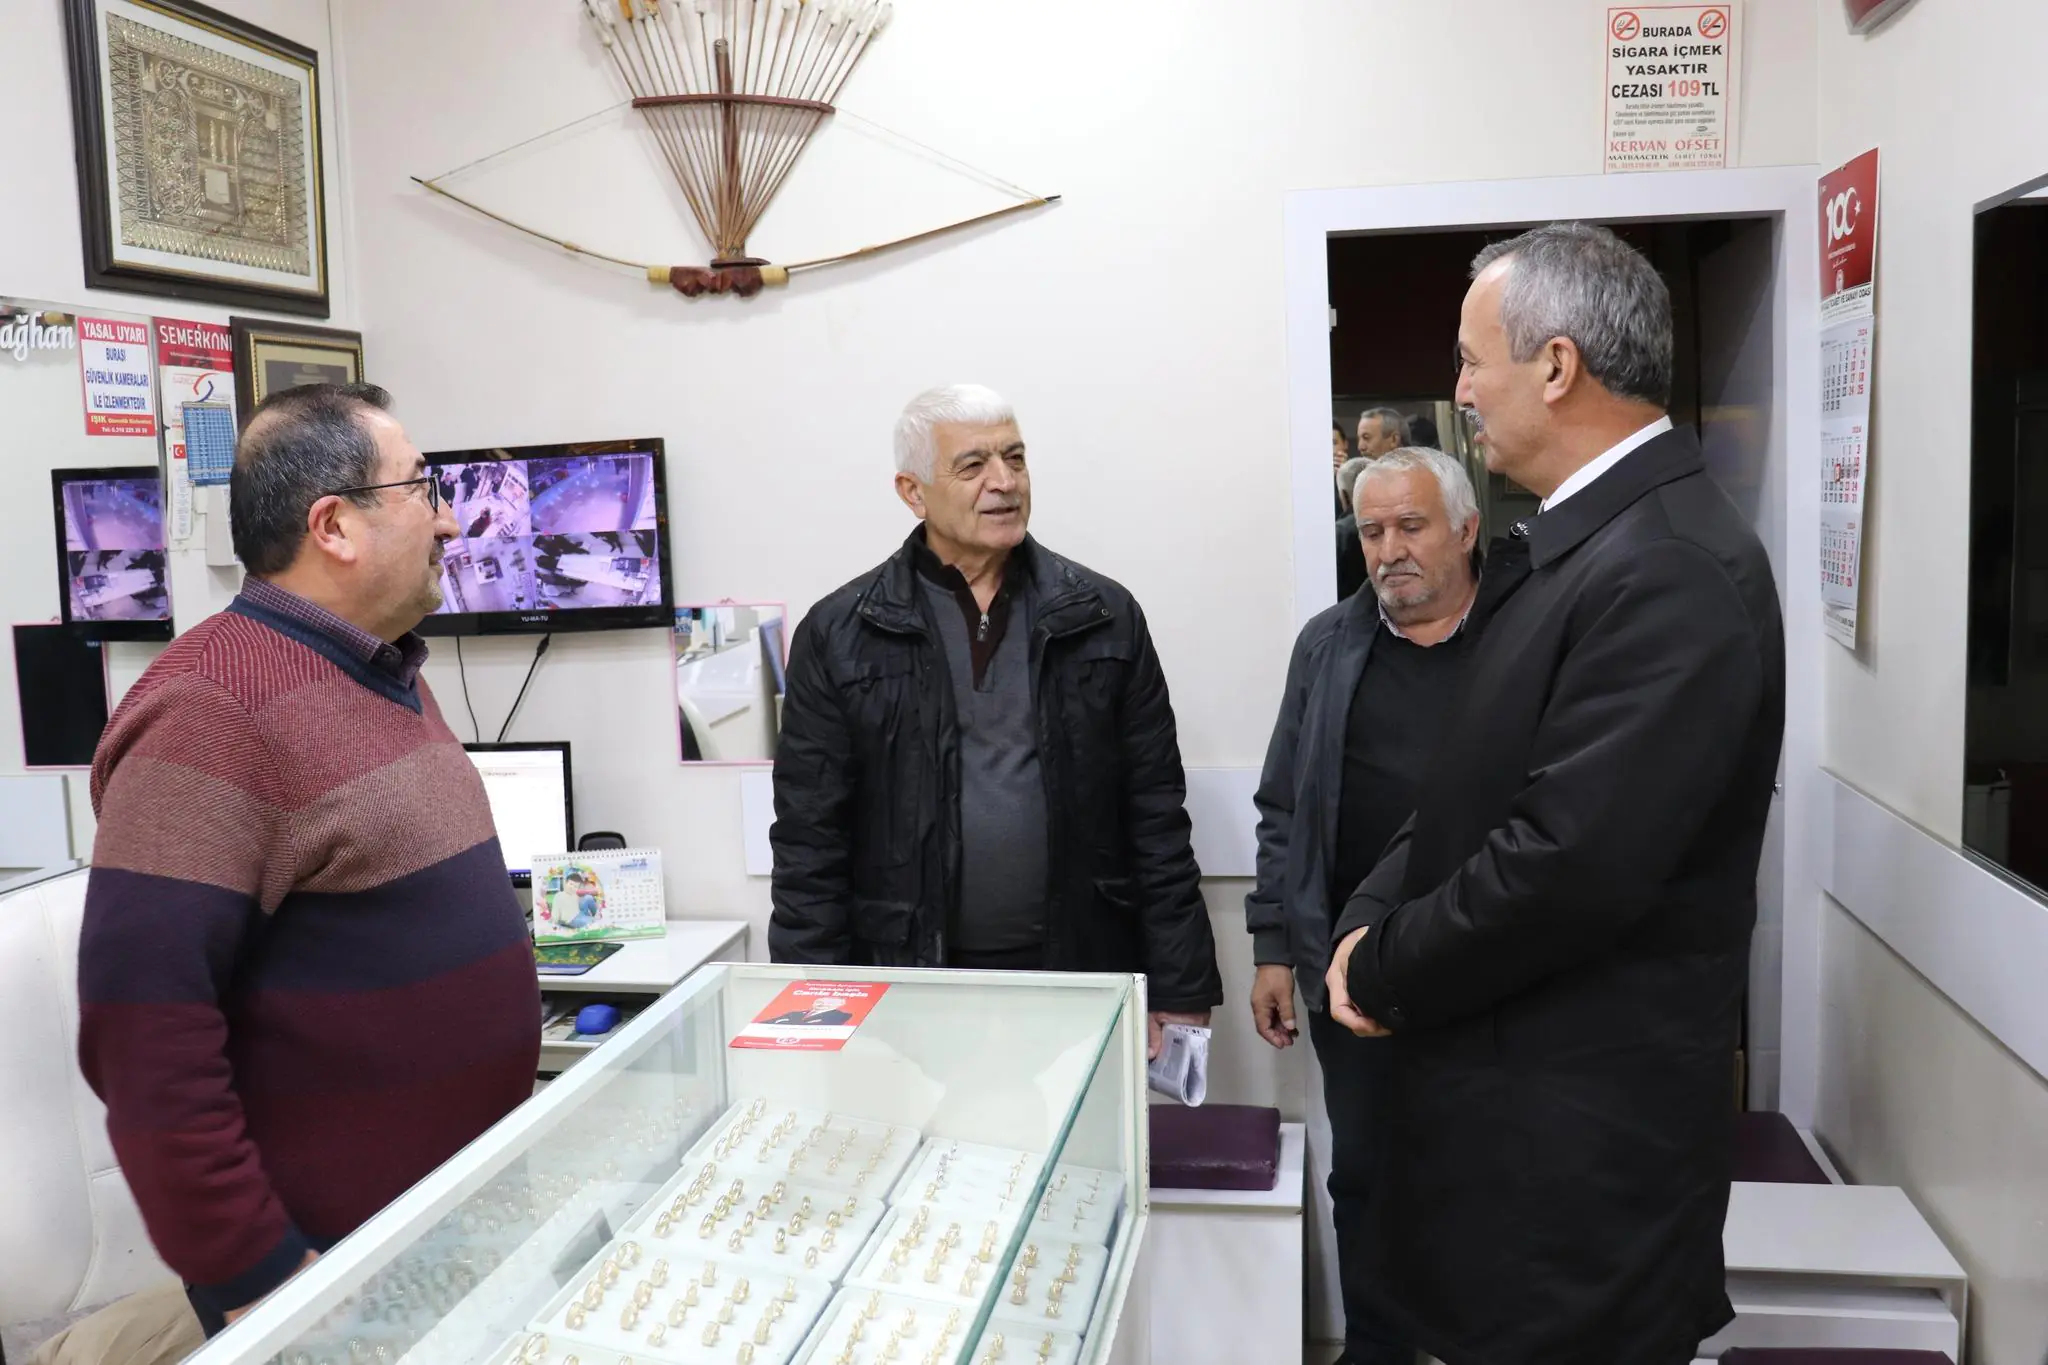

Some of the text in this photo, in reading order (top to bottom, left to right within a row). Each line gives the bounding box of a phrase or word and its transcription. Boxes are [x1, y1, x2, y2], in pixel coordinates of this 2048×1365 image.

[1642, 26, 1692, 38] BURADA
[1612, 44, 1722, 58] SİGARA İÇMEK
[1626, 64, 1708, 75] YASAKTIR
[1612, 84, 1663, 98] CEZASI
[1610, 139, 1720, 152] KERVAN OFSET
[83, 322, 145, 342] YASAL UYARI
[106, 347, 126, 361] BURASI
[86, 368, 149, 387] GÜVENLİK KAMERALARI
[93, 391, 146, 409] İLE İZLENMEKTEDİR
[91, 415, 107, 424] IŞIK
